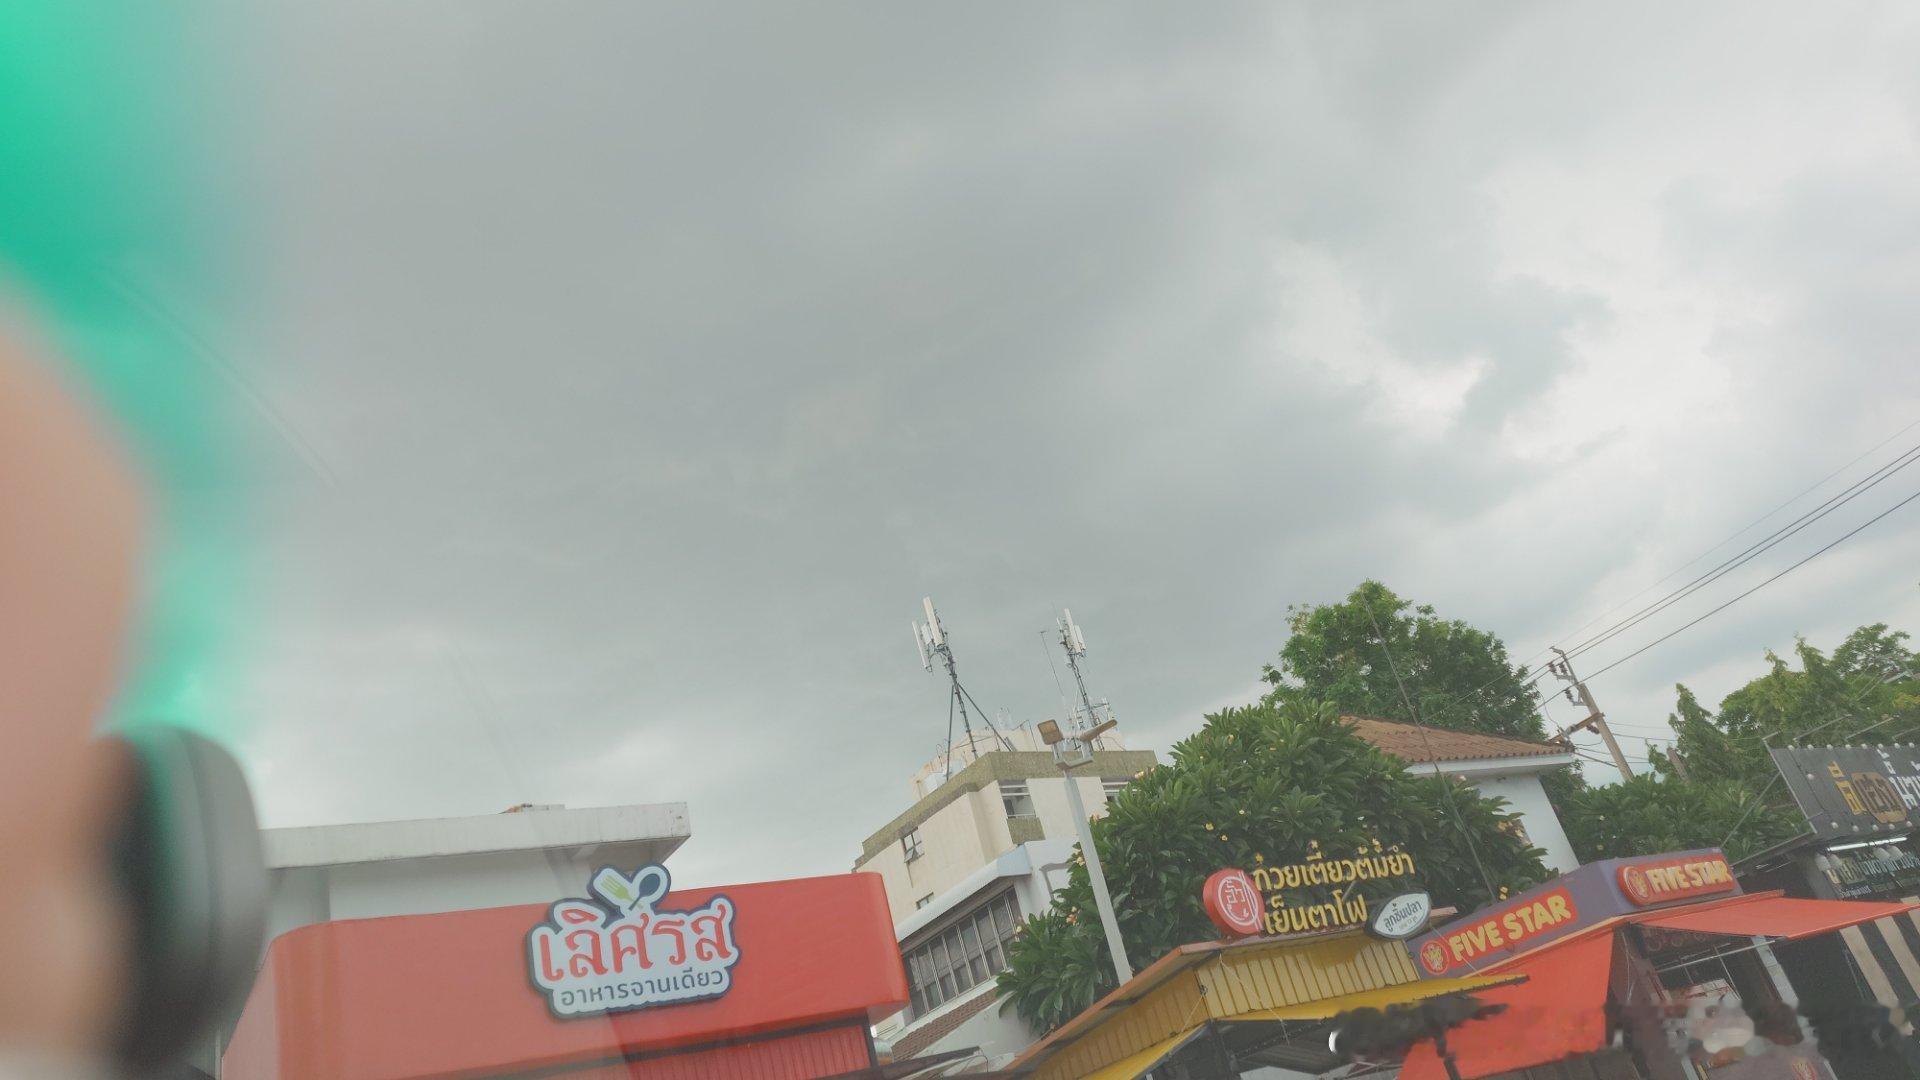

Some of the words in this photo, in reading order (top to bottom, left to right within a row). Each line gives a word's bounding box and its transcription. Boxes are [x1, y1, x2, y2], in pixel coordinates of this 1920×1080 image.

[1646, 866, 1691, 893] FIVE
[1689, 859, 1733, 887] STAR
[1264, 889, 1368, 935] เย็นตาโฟ
[1384, 901, 1423, 933] ลูกชิ้นปลา
[1449, 925, 1504, 962] FIVE
[1501, 894, 1572, 942] STAR
[540, 902, 732, 982] เลิศรส
[561, 966, 724, 1007] อาหารจานเดียว
